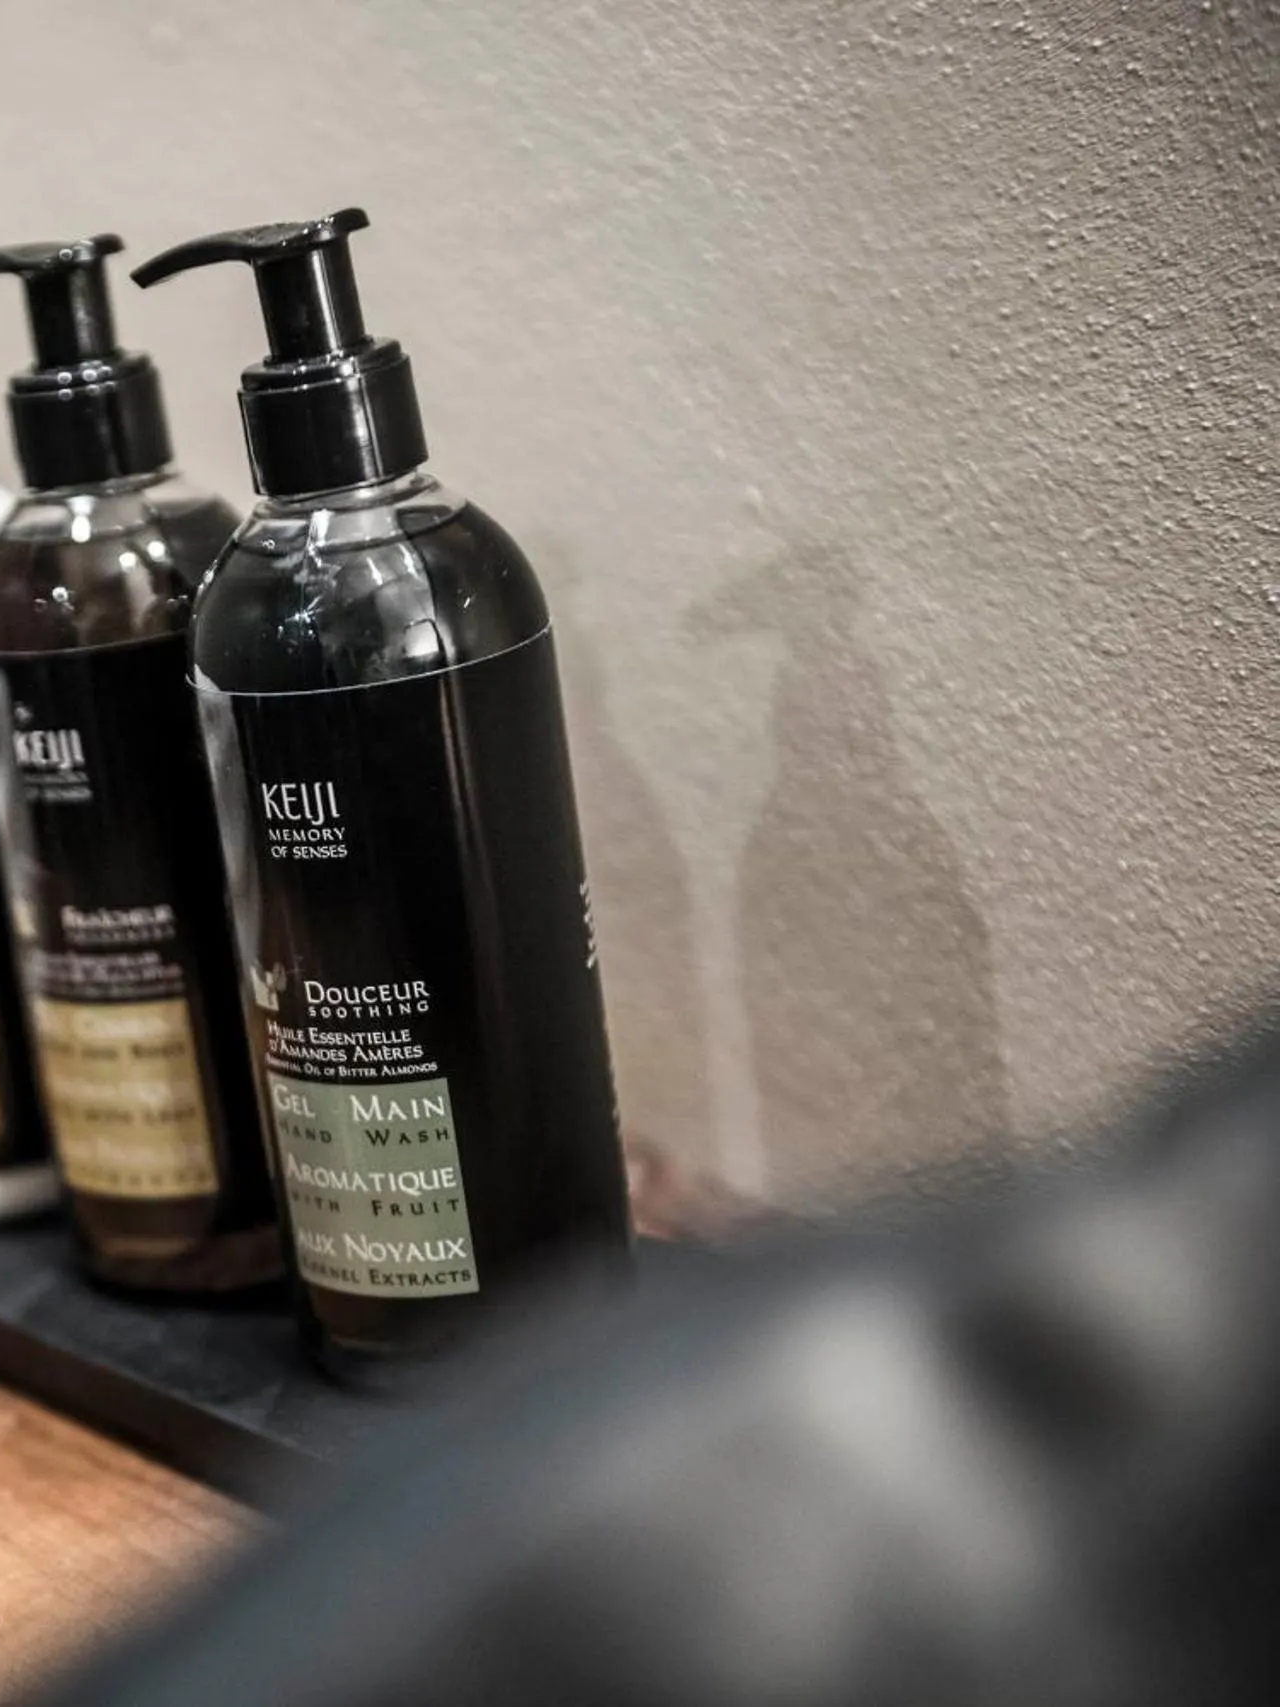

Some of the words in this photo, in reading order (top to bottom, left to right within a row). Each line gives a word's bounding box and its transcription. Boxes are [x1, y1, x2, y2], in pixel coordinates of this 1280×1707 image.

[261, 782, 340, 825] KEIJI
[268, 827, 345, 842] MEMORY
[271, 846, 287, 858] OF
[293, 845, 348, 859] SENSES
[304, 980, 430, 1004] DOUCEUR
[308, 1000, 430, 1018] SOOTHING
[308, 1027, 412, 1045] ESSENTIELLE
[353, 1045, 424, 1063] AMÈRES
[338, 1065, 378, 1077] BITTER
[381, 1061, 438, 1077] ALMONDS
[273, 1083, 316, 1118] GEL
[350, 1094, 446, 1122] MAIN
[365, 1127, 451, 1146] WASH
[286, 1152, 457, 1196] AROMATIQUE
[371, 1198, 460, 1217] FRUIT
[342, 1232, 468, 1263] NOYAUX
[369, 1268, 473, 1288] EXTRACTS
